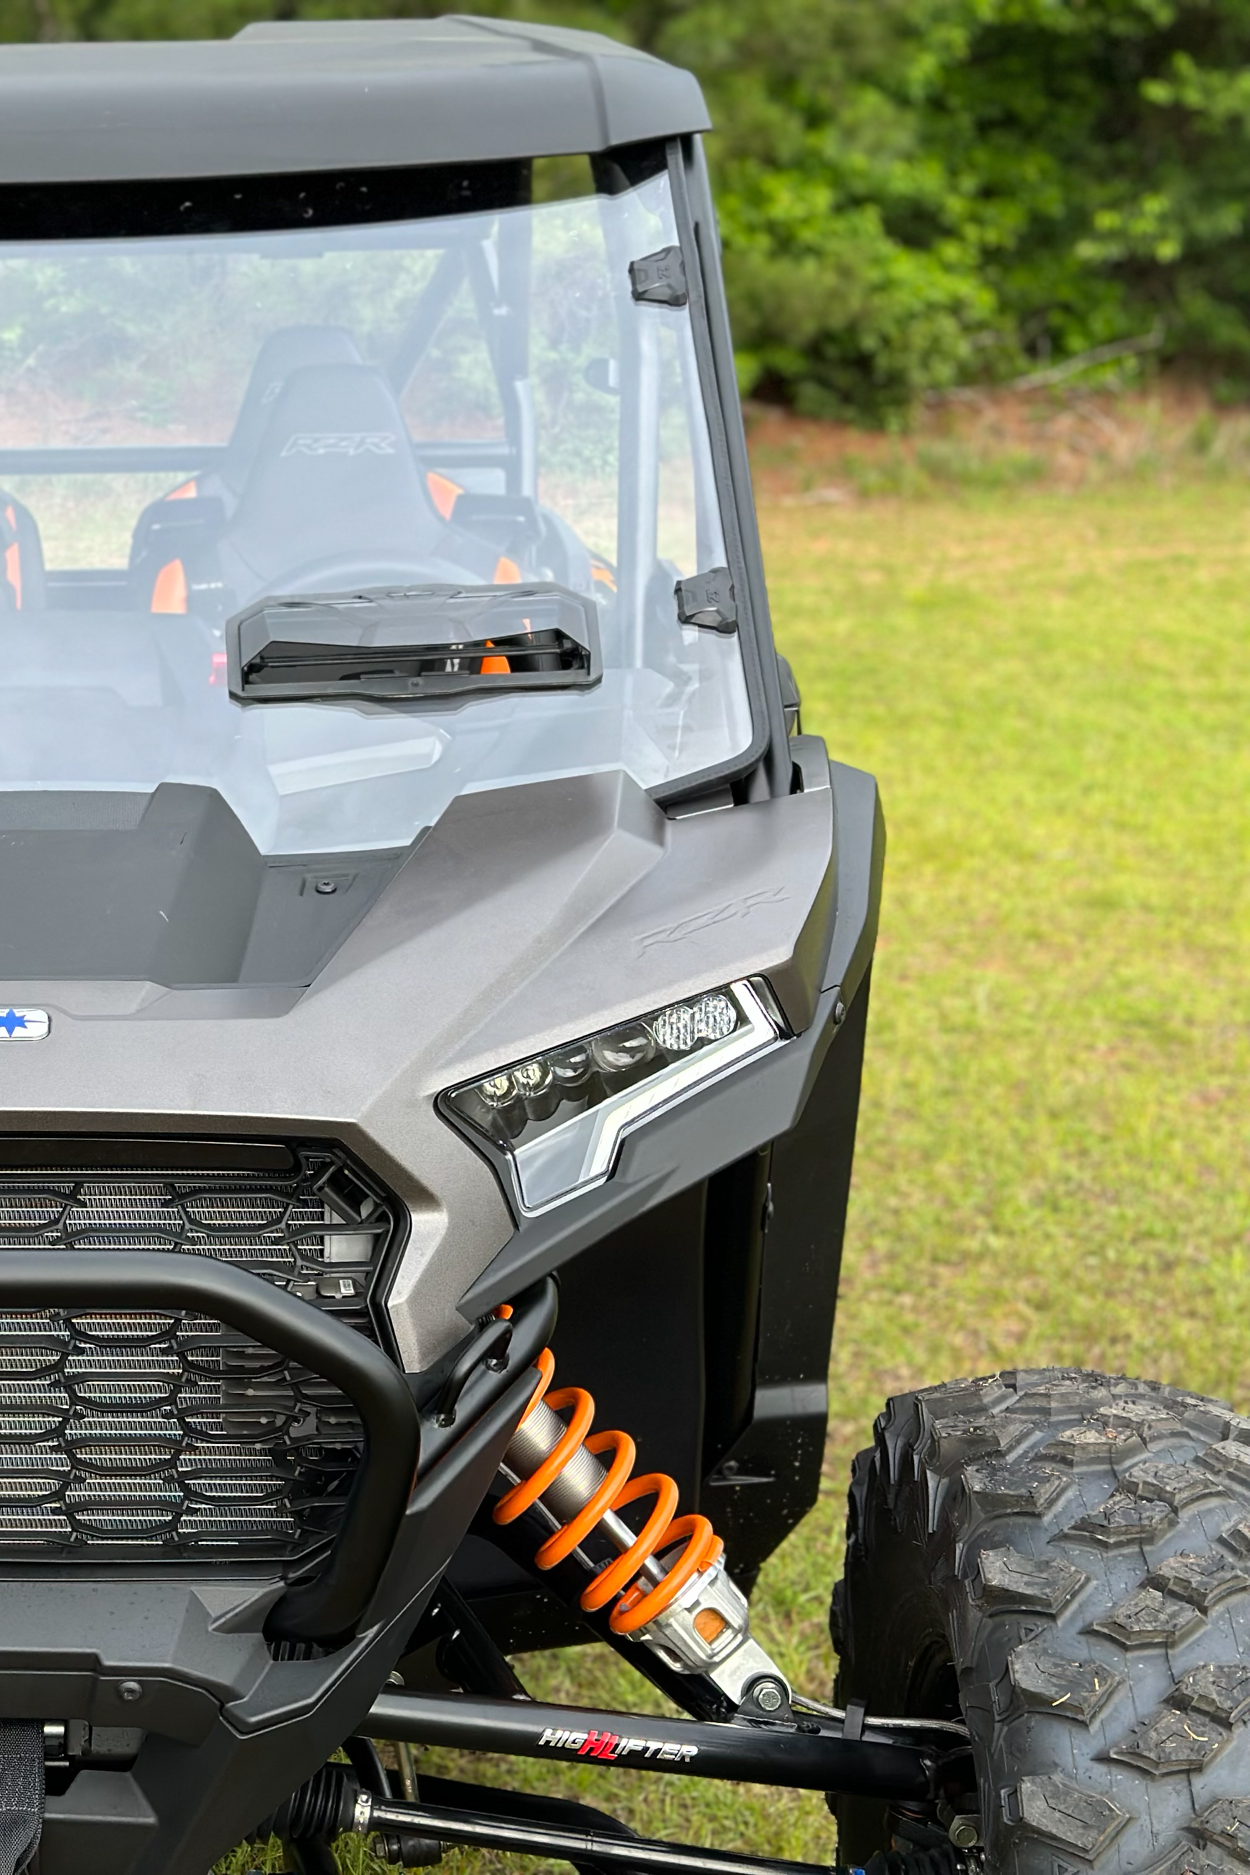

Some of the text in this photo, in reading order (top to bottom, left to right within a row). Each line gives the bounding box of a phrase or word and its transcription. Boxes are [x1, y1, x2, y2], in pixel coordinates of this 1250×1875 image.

[280, 431, 397, 457] RZR
[634, 886, 791, 961] RZR
[538, 1728, 699, 1763] HIGHLIFTER
